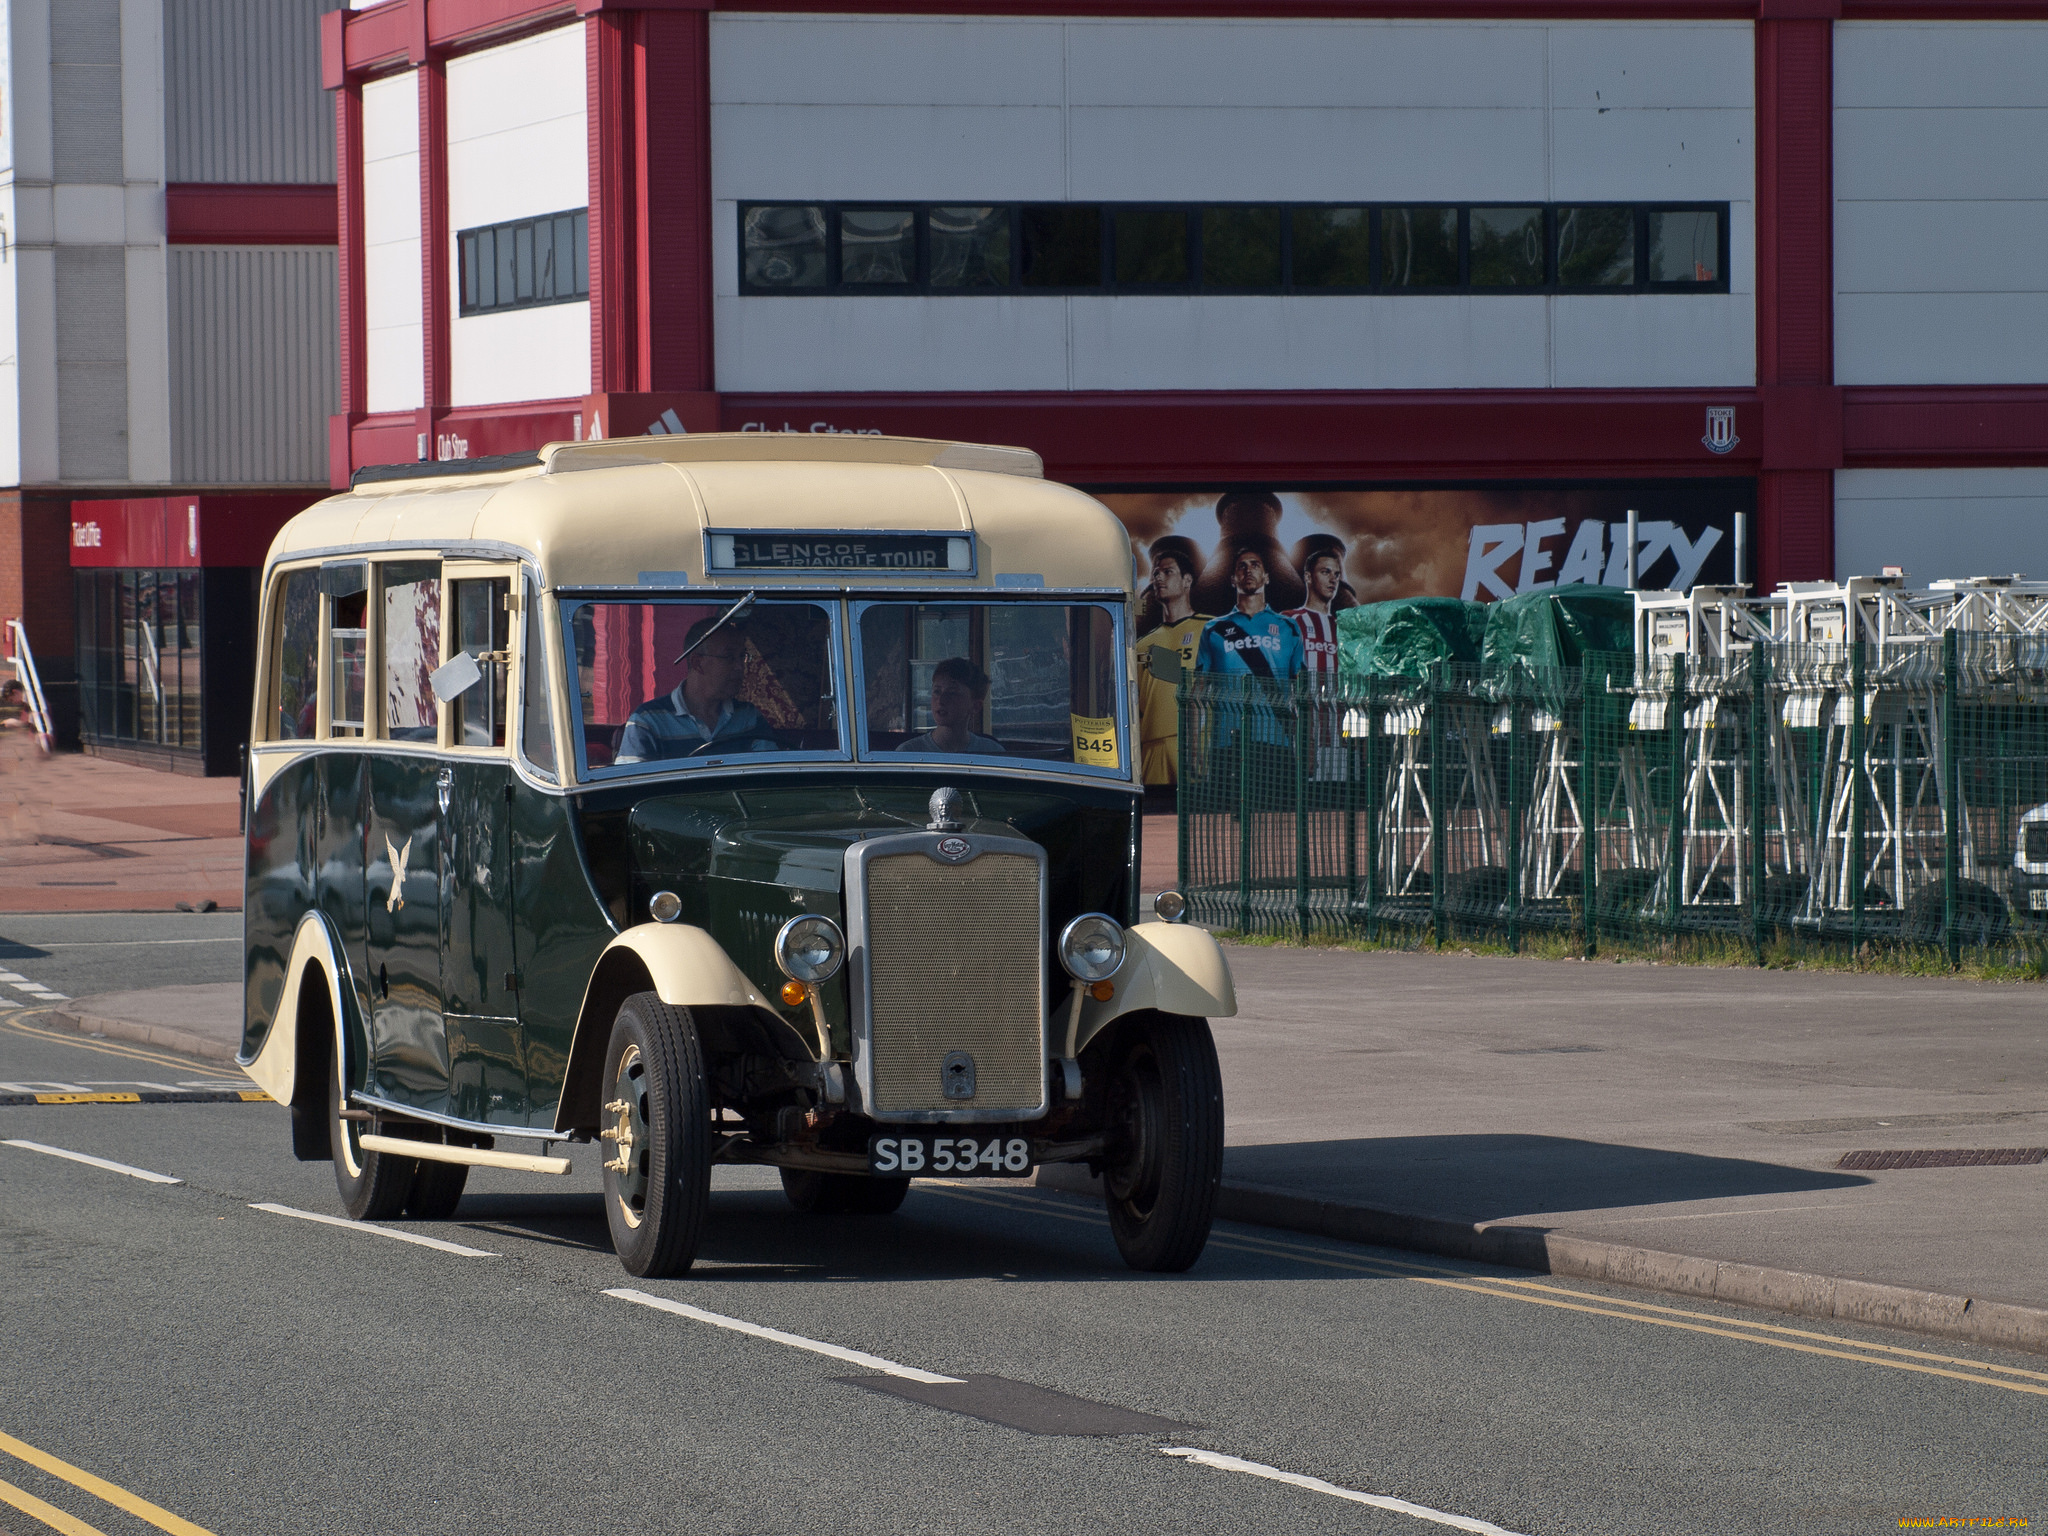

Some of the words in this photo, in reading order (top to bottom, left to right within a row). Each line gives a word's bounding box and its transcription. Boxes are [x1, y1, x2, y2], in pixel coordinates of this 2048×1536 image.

[734, 543, 867, 563] GLENCOE
[780, 553, 877, 567] TRIANGLE
[881, 550, 937, 567] TOUR
[1460, 517, 1724, 601] READY
[1223, 635, 1281, 653] bet365
[1076, 735, 1113, 752] B45
[874, 1138, 926, 1172] SB
[932, 1138, 1029, 1172] 5348
